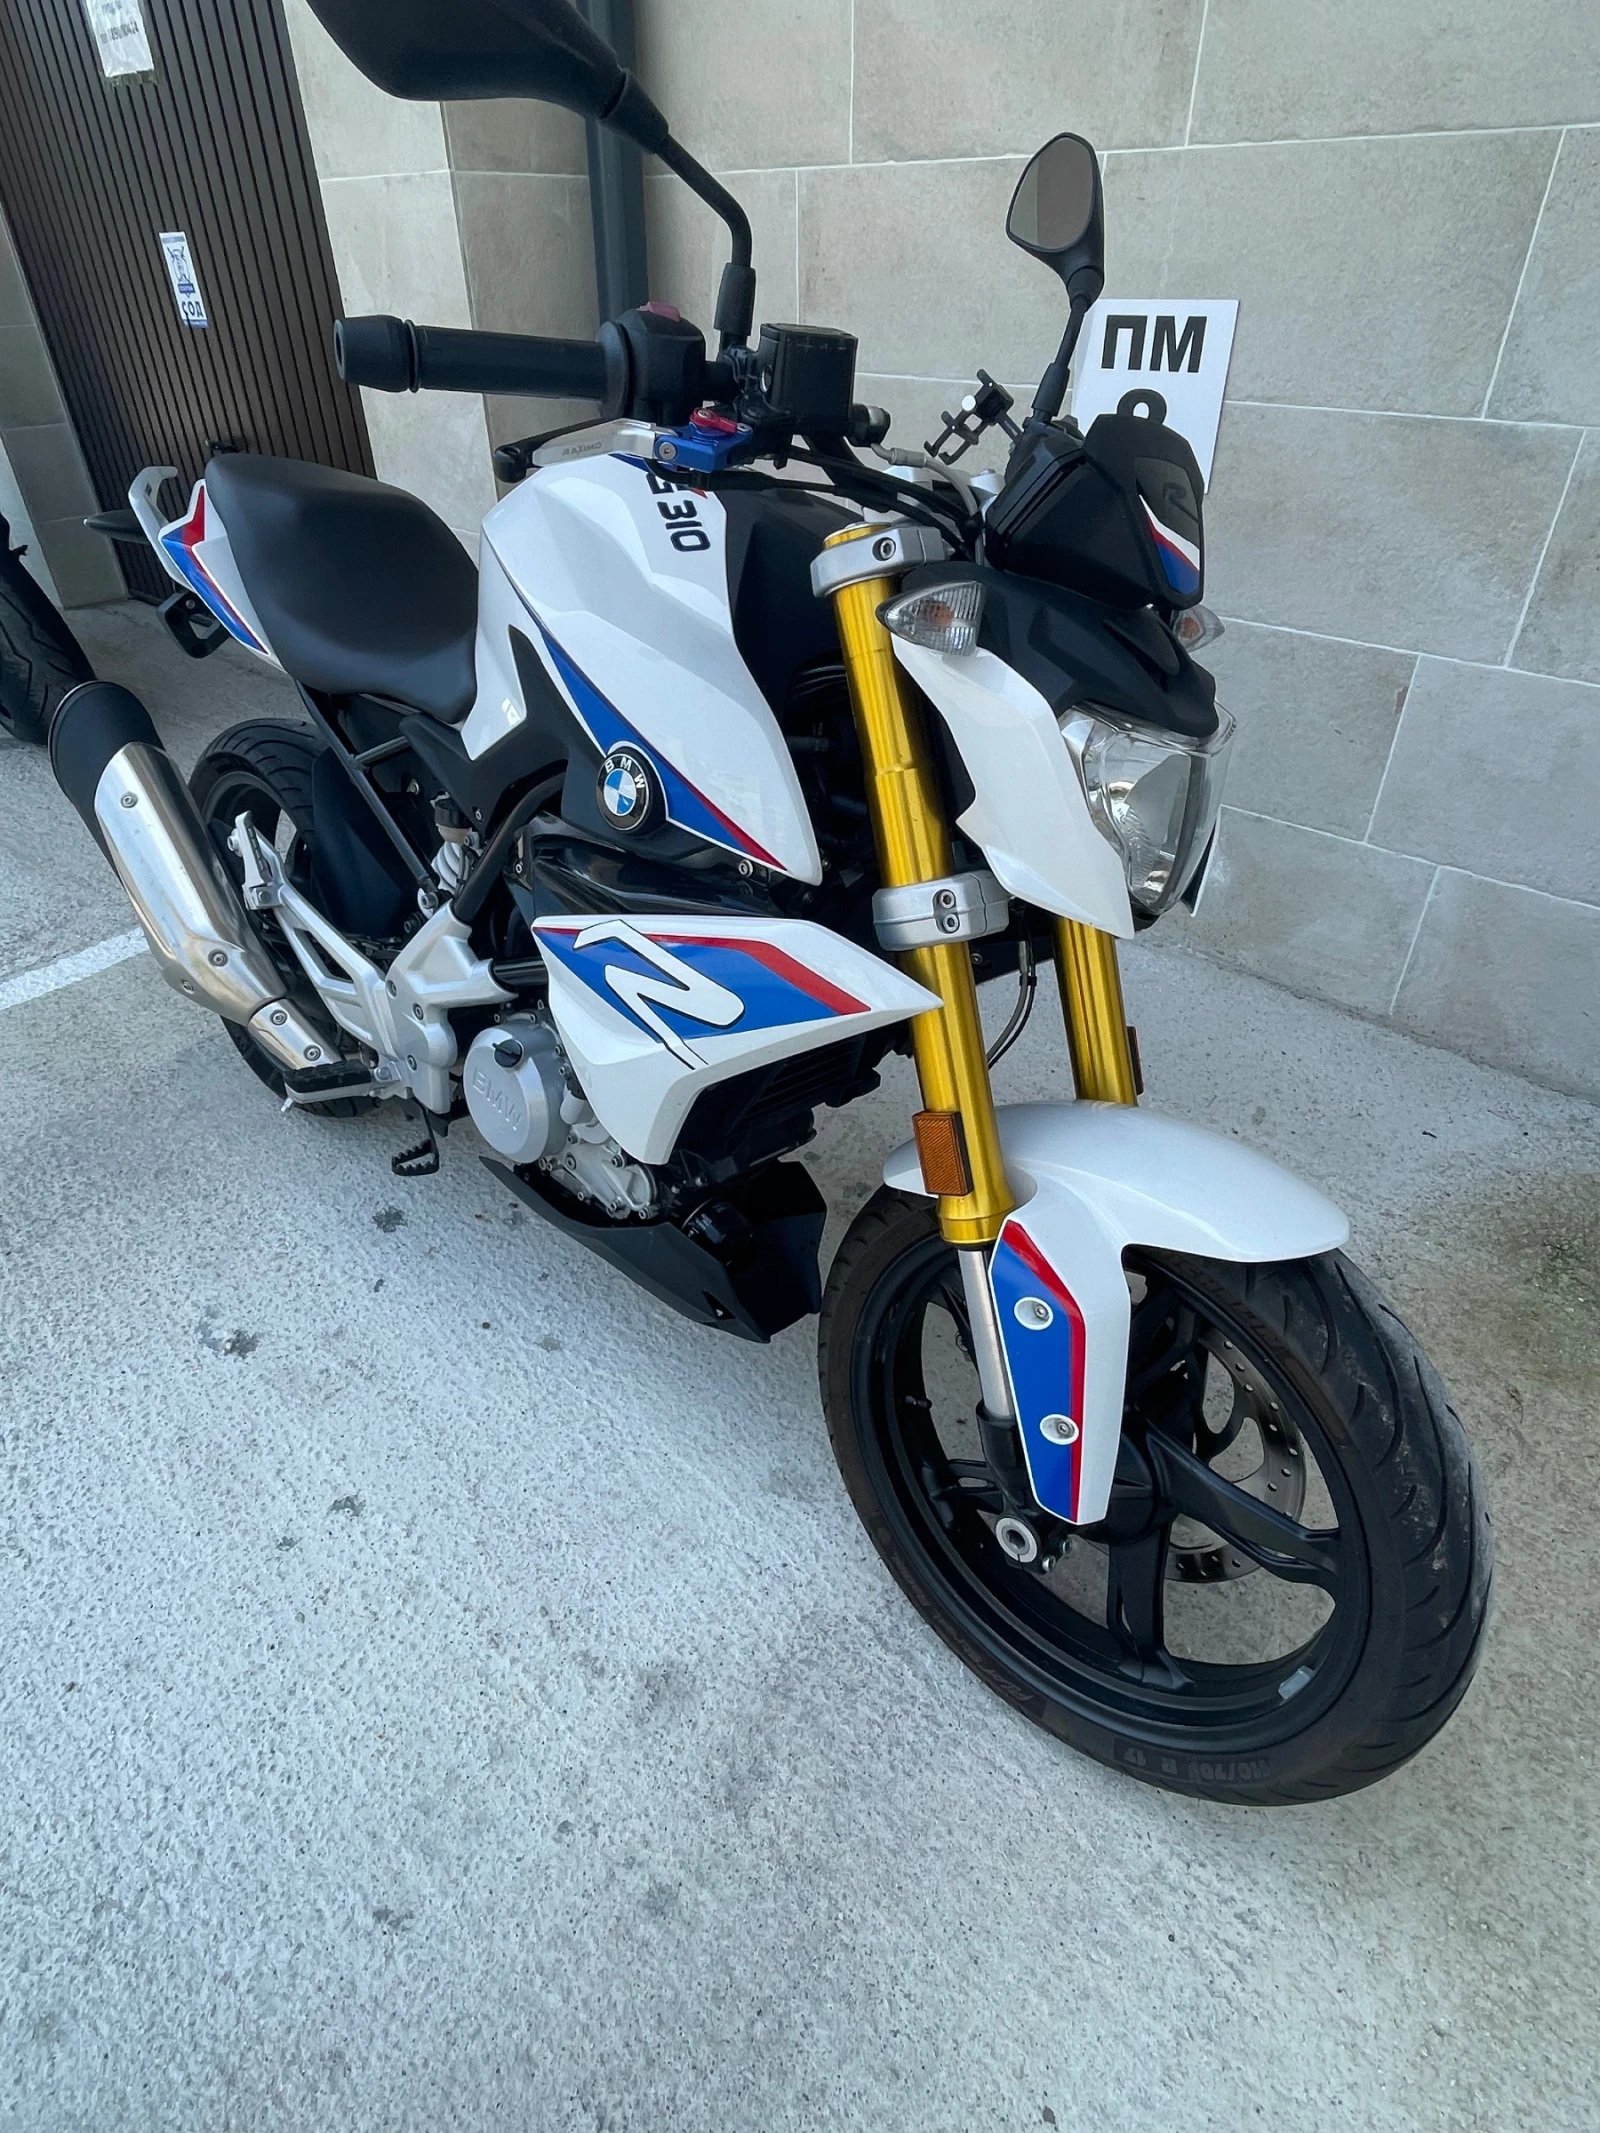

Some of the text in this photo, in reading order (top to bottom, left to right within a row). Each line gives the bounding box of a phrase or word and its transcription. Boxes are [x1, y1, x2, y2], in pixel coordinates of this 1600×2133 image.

[1101, 315, 1207, 373] ПМ
[657, 499, 711, 552] 310
[604, 756, 645, 789] BMW
[473, 1066, 521, 1131] BMW
[1123, 1747, 1148, 1766] 17
[1160, 1756, 1178, 1775] R
